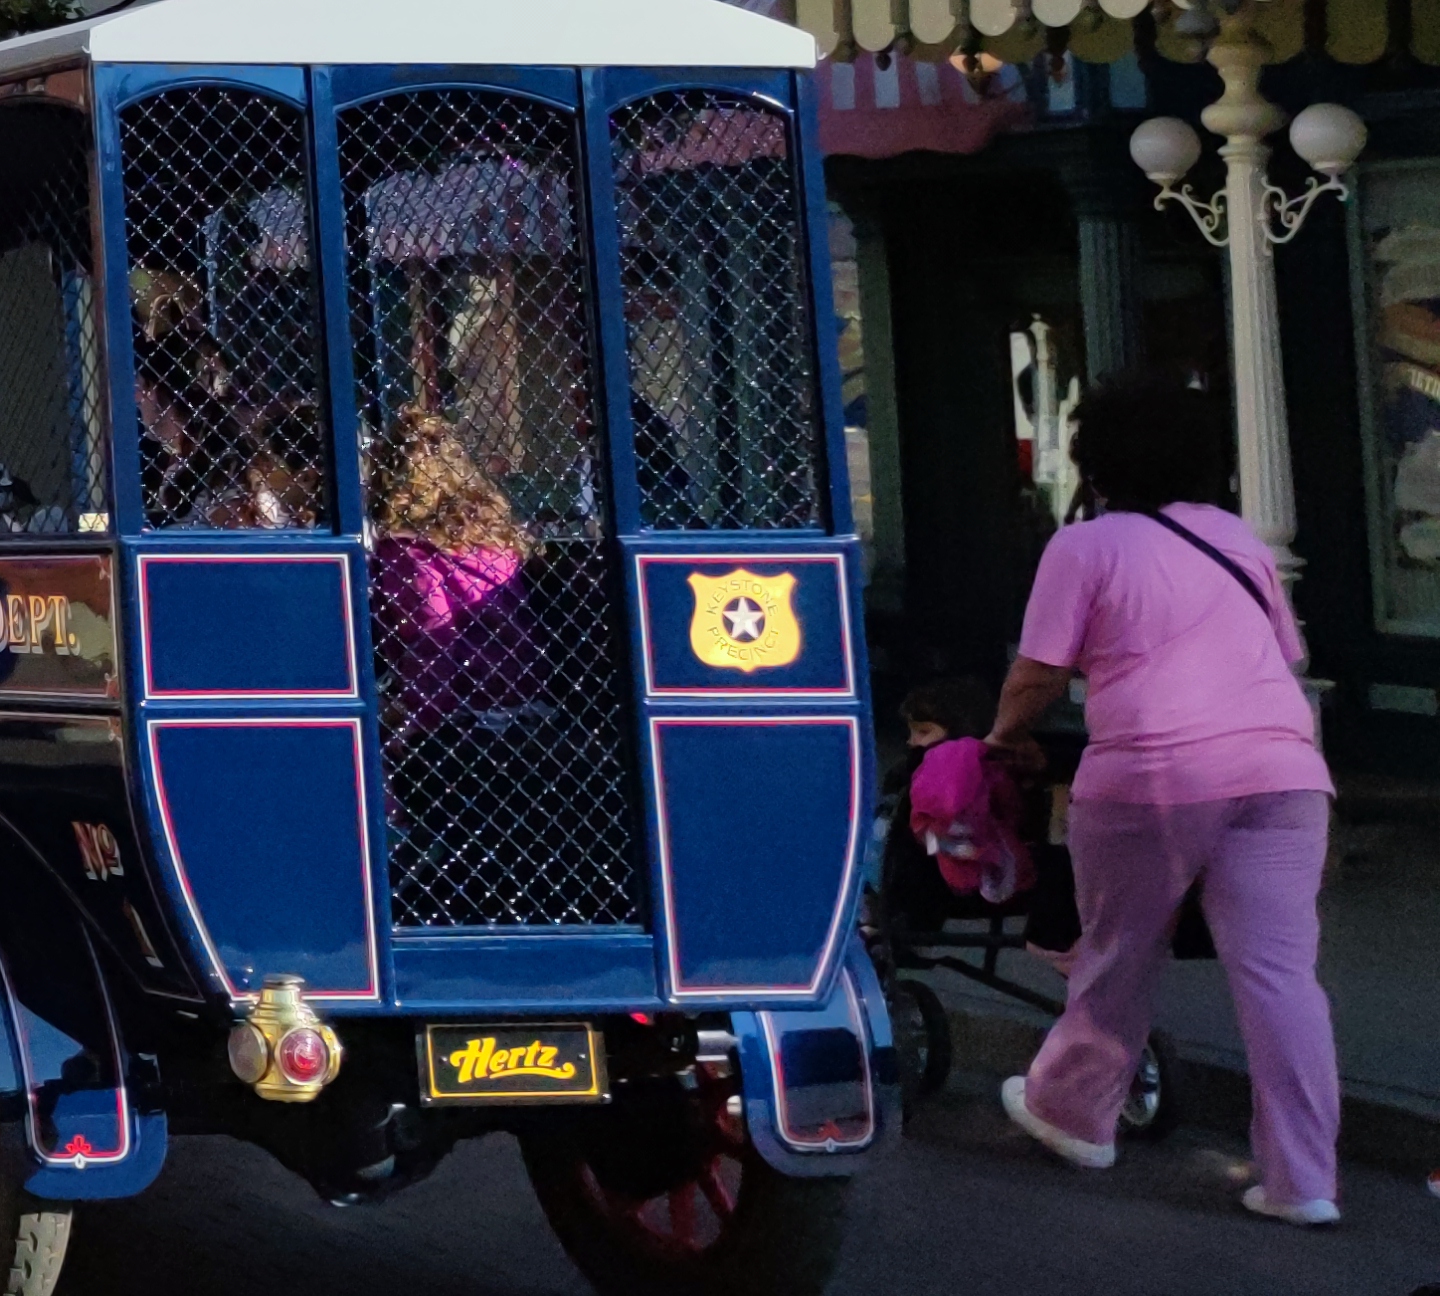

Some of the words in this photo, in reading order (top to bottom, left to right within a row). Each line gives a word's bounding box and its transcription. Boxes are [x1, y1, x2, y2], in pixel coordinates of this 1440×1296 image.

[706, 579, 779, 616] KEYSTONE
[707, 626, 779, 661] PRECINCT
[449, 1036, 577, 1084] Hertz
